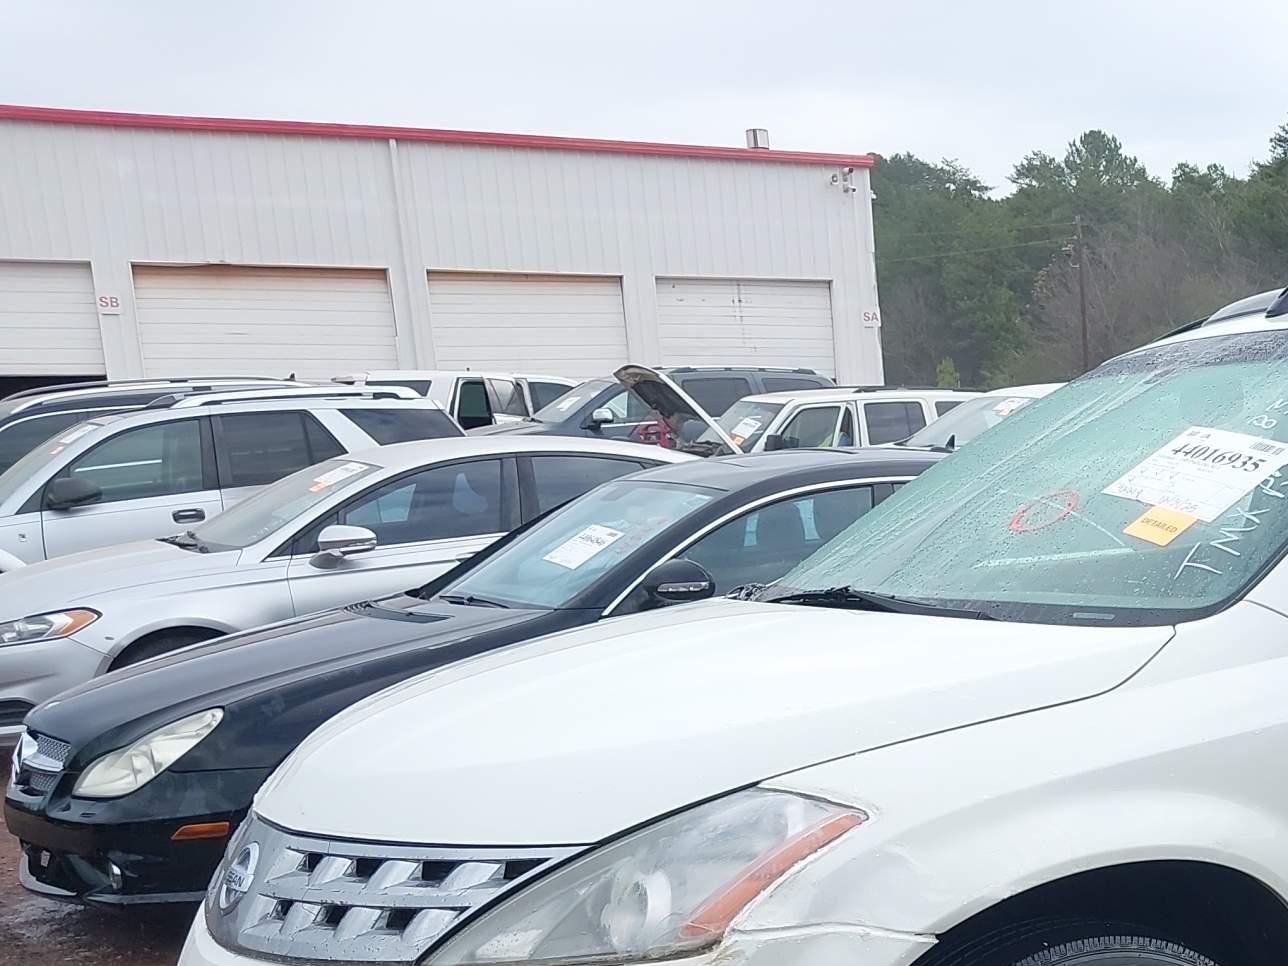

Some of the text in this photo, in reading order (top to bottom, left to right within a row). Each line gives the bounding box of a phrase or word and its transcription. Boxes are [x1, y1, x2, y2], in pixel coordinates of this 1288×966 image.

[99, 296, 119, 307] SB
[863, 311, 879, 321] SA
[1171, 442, 1267, 473] 44016935
[1140, 517, 1178, 534] DETAILED
[1173, 507, 1271, 580] TMX
